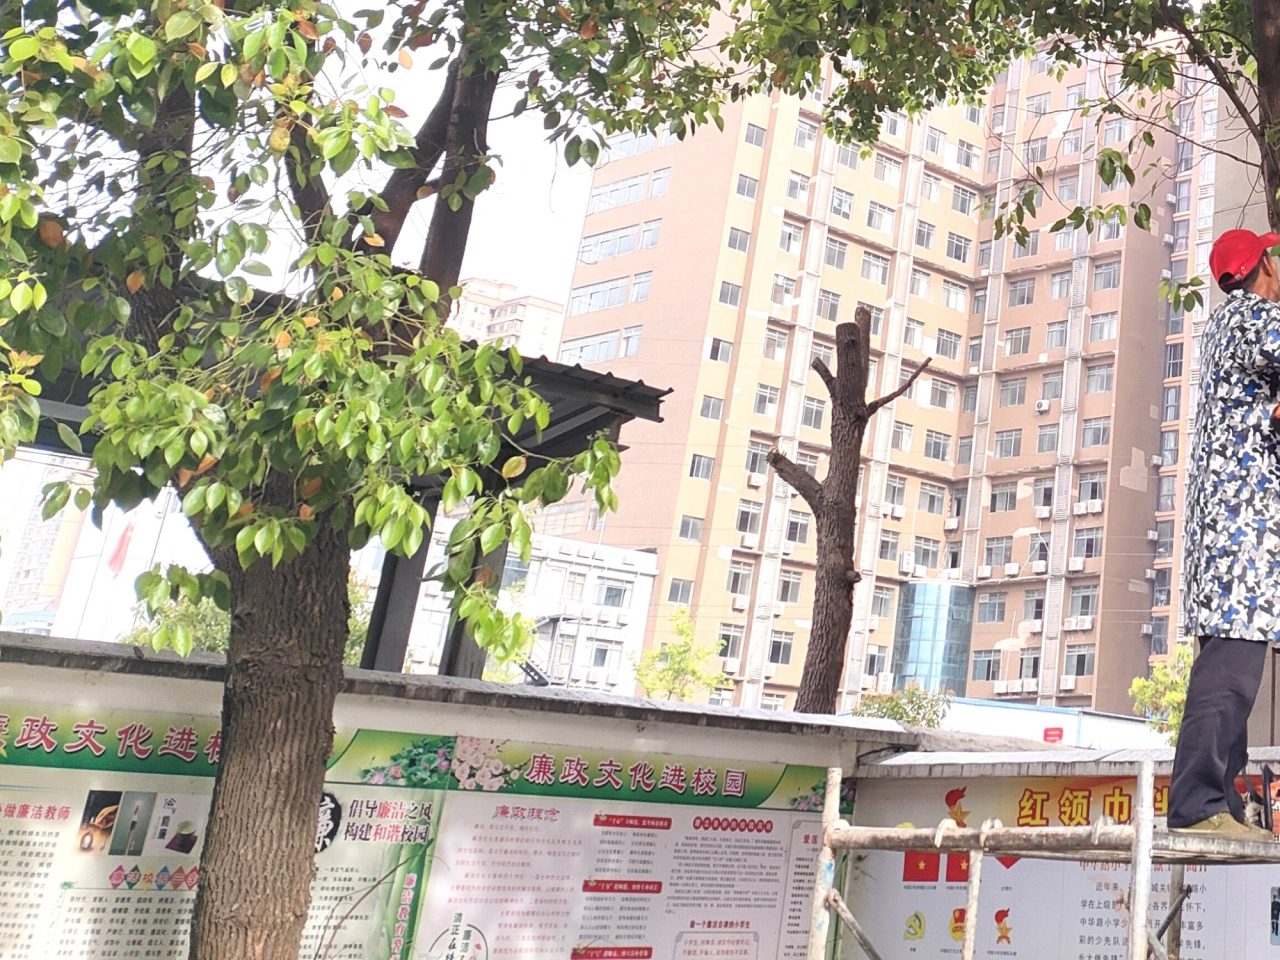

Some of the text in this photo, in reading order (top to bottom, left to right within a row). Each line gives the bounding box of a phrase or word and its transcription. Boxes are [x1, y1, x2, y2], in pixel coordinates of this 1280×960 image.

[525, 752, 747, 796] 廉政文化进校园
[0, 802, 71, 821] 做廉洁教师
[349, 799, 432, 820] 倡导廉洁之风
[344, 822, 429, 842] 构建和谐校园
